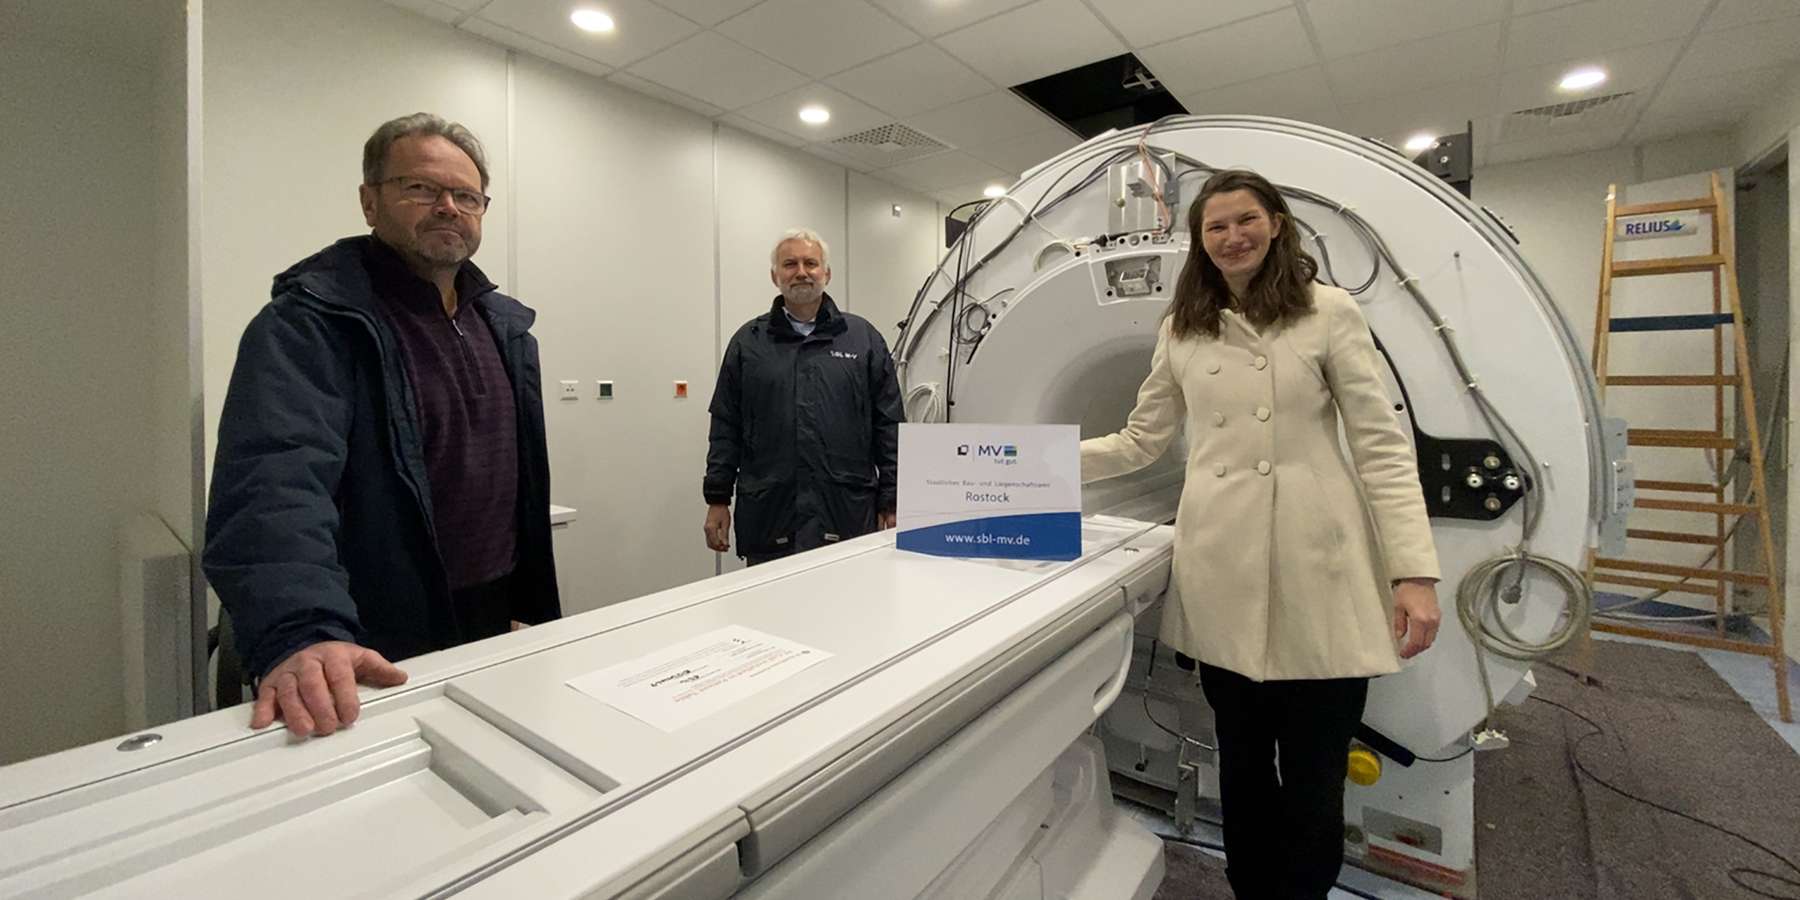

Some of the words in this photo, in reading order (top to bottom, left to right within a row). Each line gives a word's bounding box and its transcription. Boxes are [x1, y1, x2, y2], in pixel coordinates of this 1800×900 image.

[1626, 220, 1670, 235] RELIUS
[978, 445, 1002, 456] MV
[965, 491, 1010, 503] Rostock
[945, 532, 1030, 546] www.sbl-mv.de
